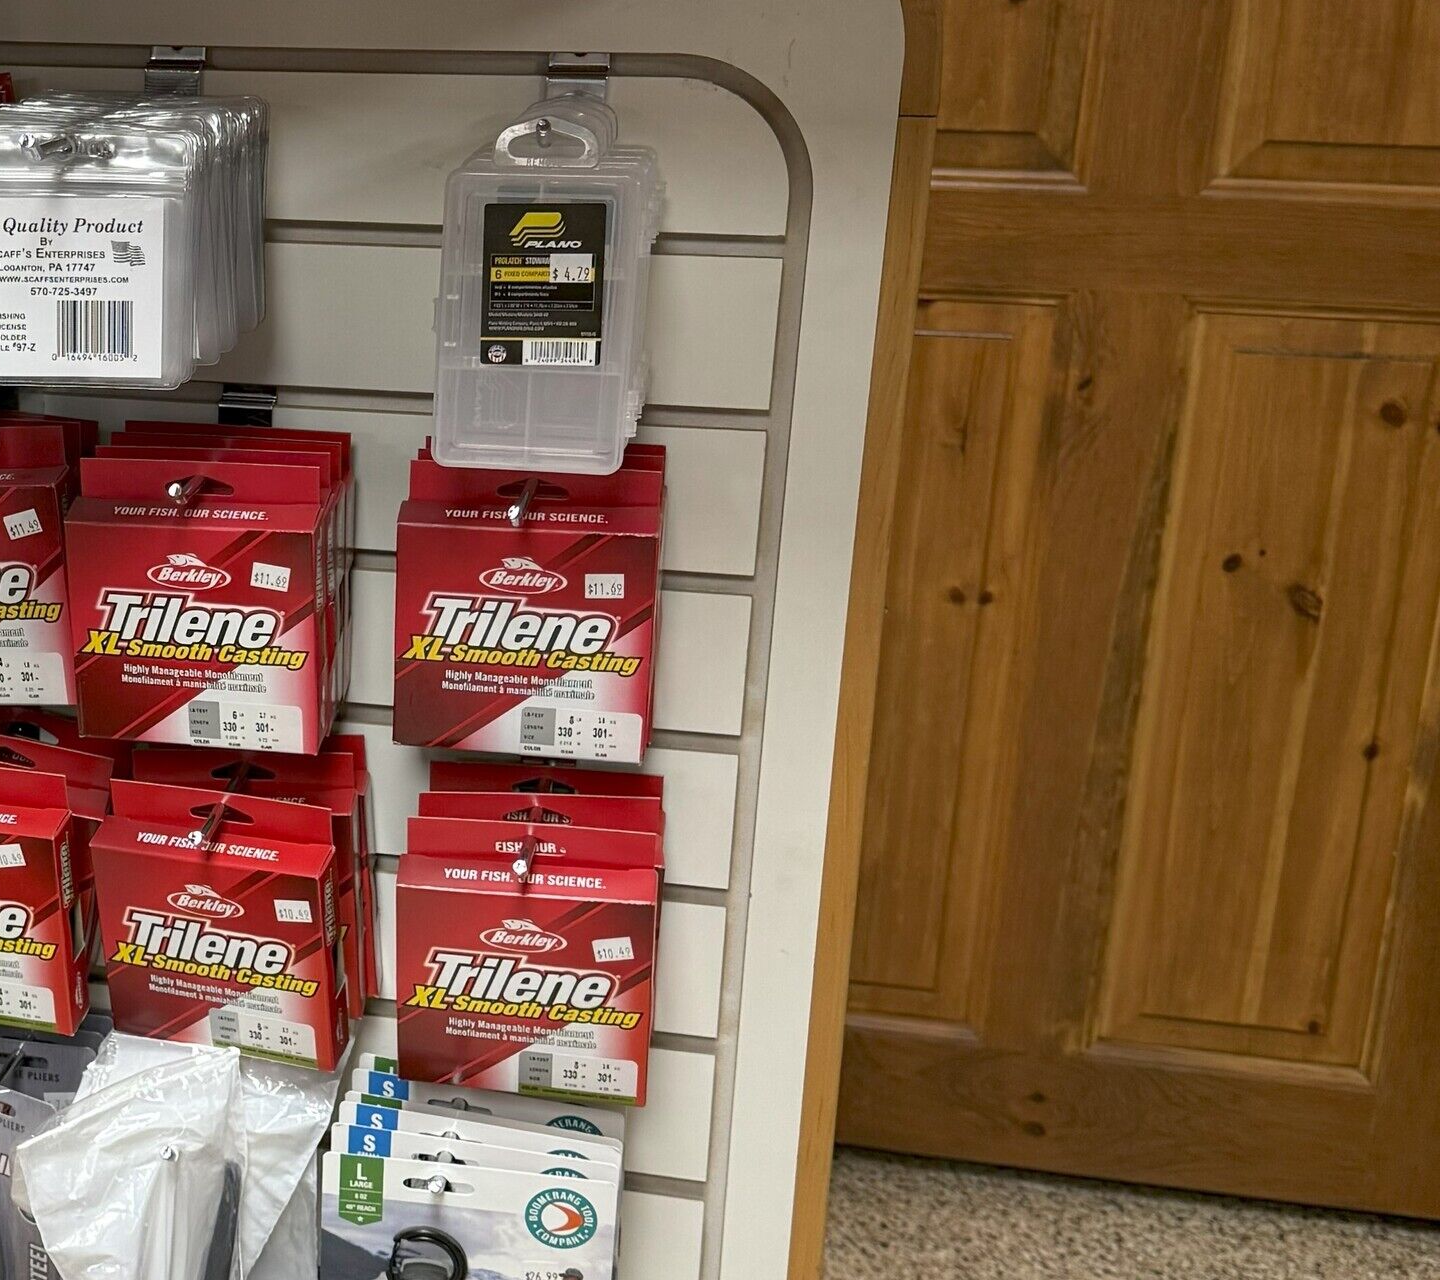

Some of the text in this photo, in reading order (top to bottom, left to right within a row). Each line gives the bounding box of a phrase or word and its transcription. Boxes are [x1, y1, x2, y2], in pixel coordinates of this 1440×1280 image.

[2, 218, 68, 236] Quality
[73, 218, 144, 235] Product
[35, 248, 106, 259] ENTERPRISES
[524, 240, 582, 249] PLANO
[48, 263, 62, 272] PA
[66, 263, 95, 272] 17747
[30, 287, 97, 296] 570-725-3497
[113, 506, 146, 516] YOUR
[184, 509, 209, 519] OUR
[212, 509, 269, 521] SCIENCE.
[160, 567, 221, 587] Berkley
[490, 571, 556, 589] Berkley
[105, 594, 278, 649] Trilene
[432, 598, 611, 654] Trilene
[82, 630, 308, 668] XL Smooth Casting
[403, 636, 641, 676] XL Smooth Casting
[492, 929, 557, 950] Berkley
[433, 953, 610, 1010] Trilene
[349, 1179, 373, 1189] LARGE
[528, 1191, 594, 1227] BOOMERANG TOOL
[535, 1228, 585, 1246] COMPANY
